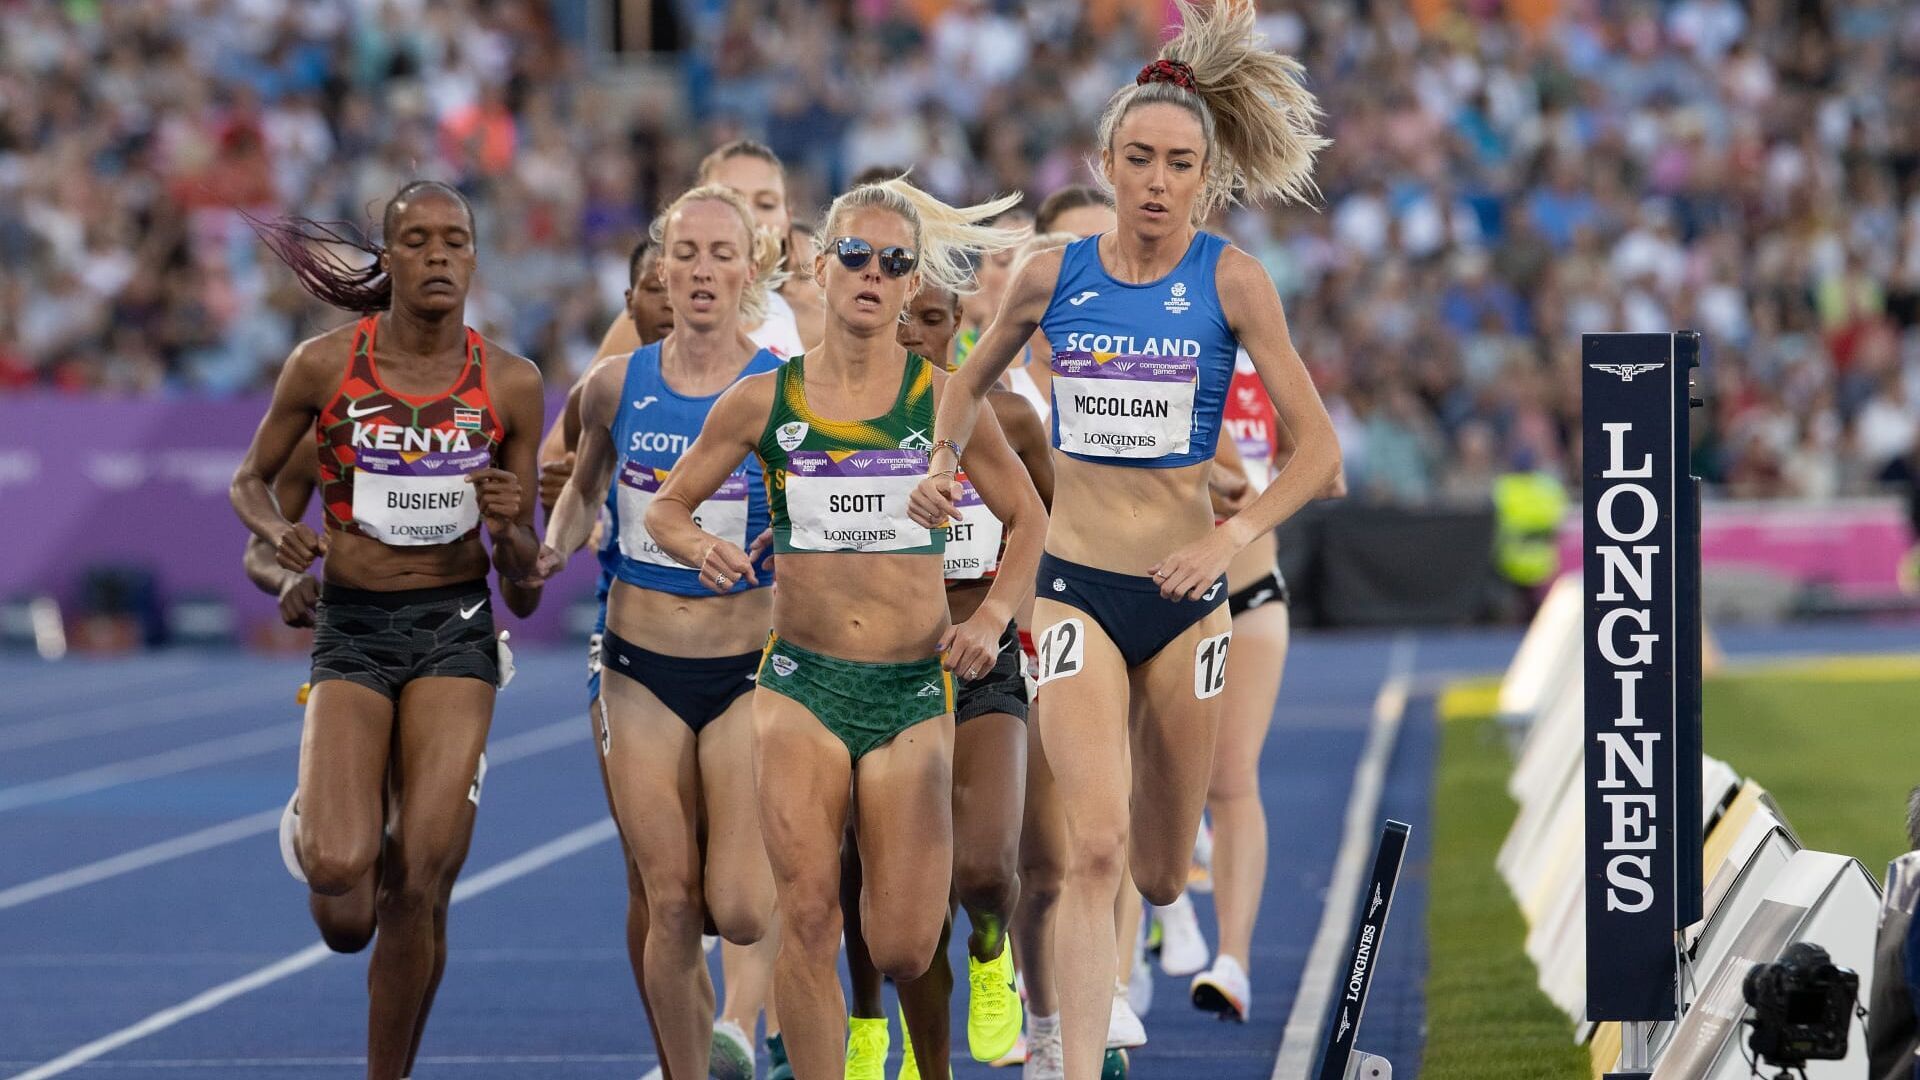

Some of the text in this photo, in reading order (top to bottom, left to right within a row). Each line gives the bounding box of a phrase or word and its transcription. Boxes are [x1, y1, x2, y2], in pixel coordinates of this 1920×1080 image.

[1066, 333, 1201, 358] SCOTLAND
[1139, 362, 1191, 370] commonwealth
[1152, 368, 1177, 376] games
[1074, 395, 1168, 418] MCCOLGAN
[351, 421, 472, 453] KENYA
[1084, 432, 1156, 447] LONGINES
[829, 494, 886, 513] SCOTT
[824, 530, 897, 541] LONGINES
[1041, 622, 1077, 679] 12
[1200, 636, 1230, 693] 12
[1596, 422, 1661, 913] LONGINES
[1347, 925, 1376, 1002] LONGINES
